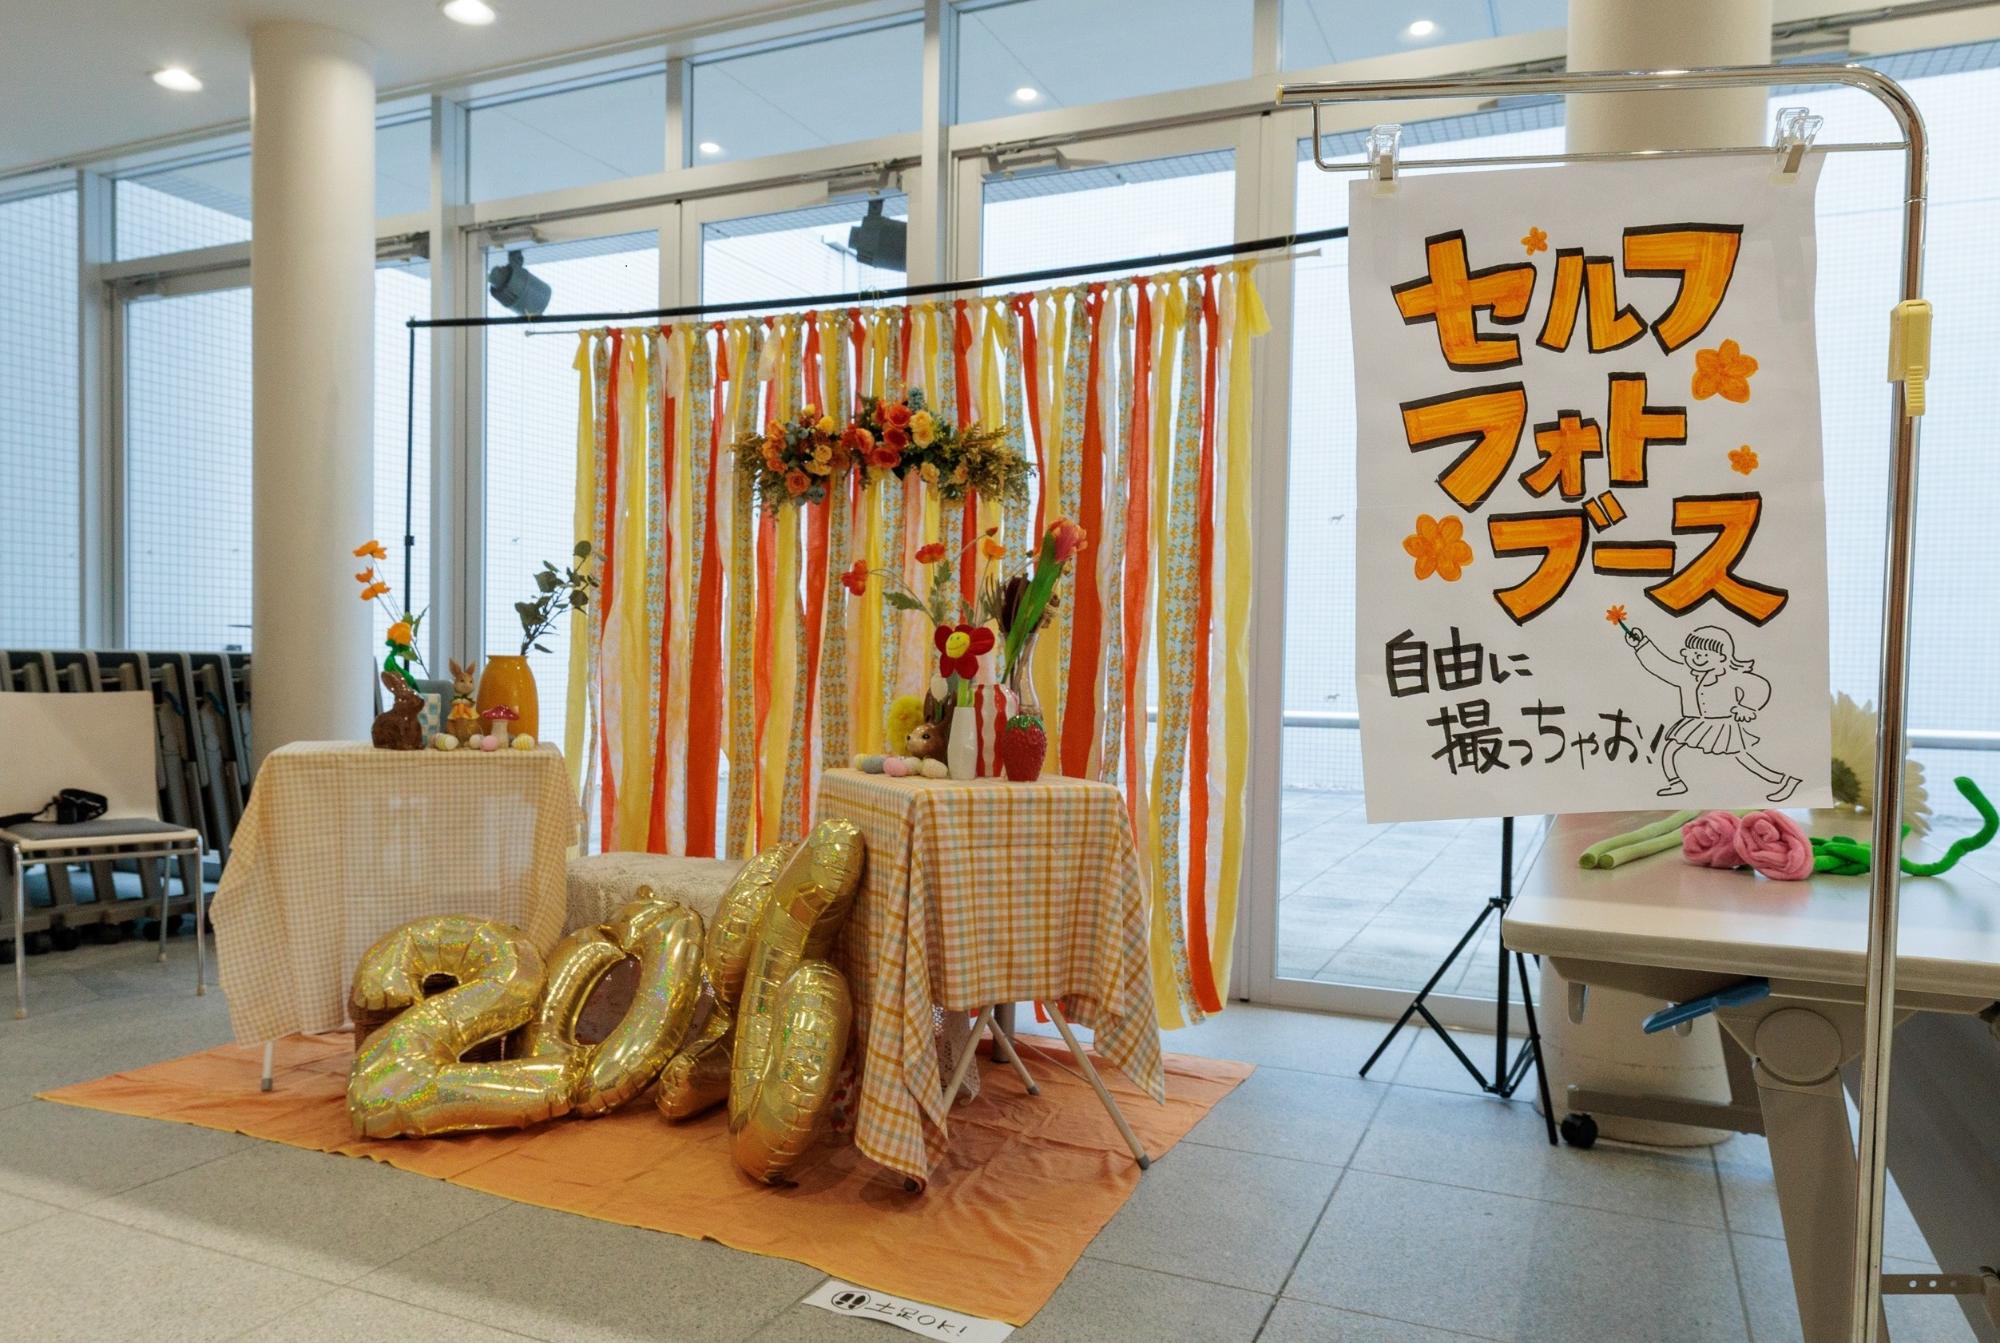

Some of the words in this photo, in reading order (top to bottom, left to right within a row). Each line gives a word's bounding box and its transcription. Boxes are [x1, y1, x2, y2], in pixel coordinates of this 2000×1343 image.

[1391, 222, 1744, 372] セルフ
[1400, 371, 1687, 513] フォト
[1487, 490, 1790, 627] ブース
[1386, 626, 1533, 698] 自由に
[1427, 698, 1666, 776] 撮っちゃお!
[864, 1302, 968, 1337] 土足OK!
